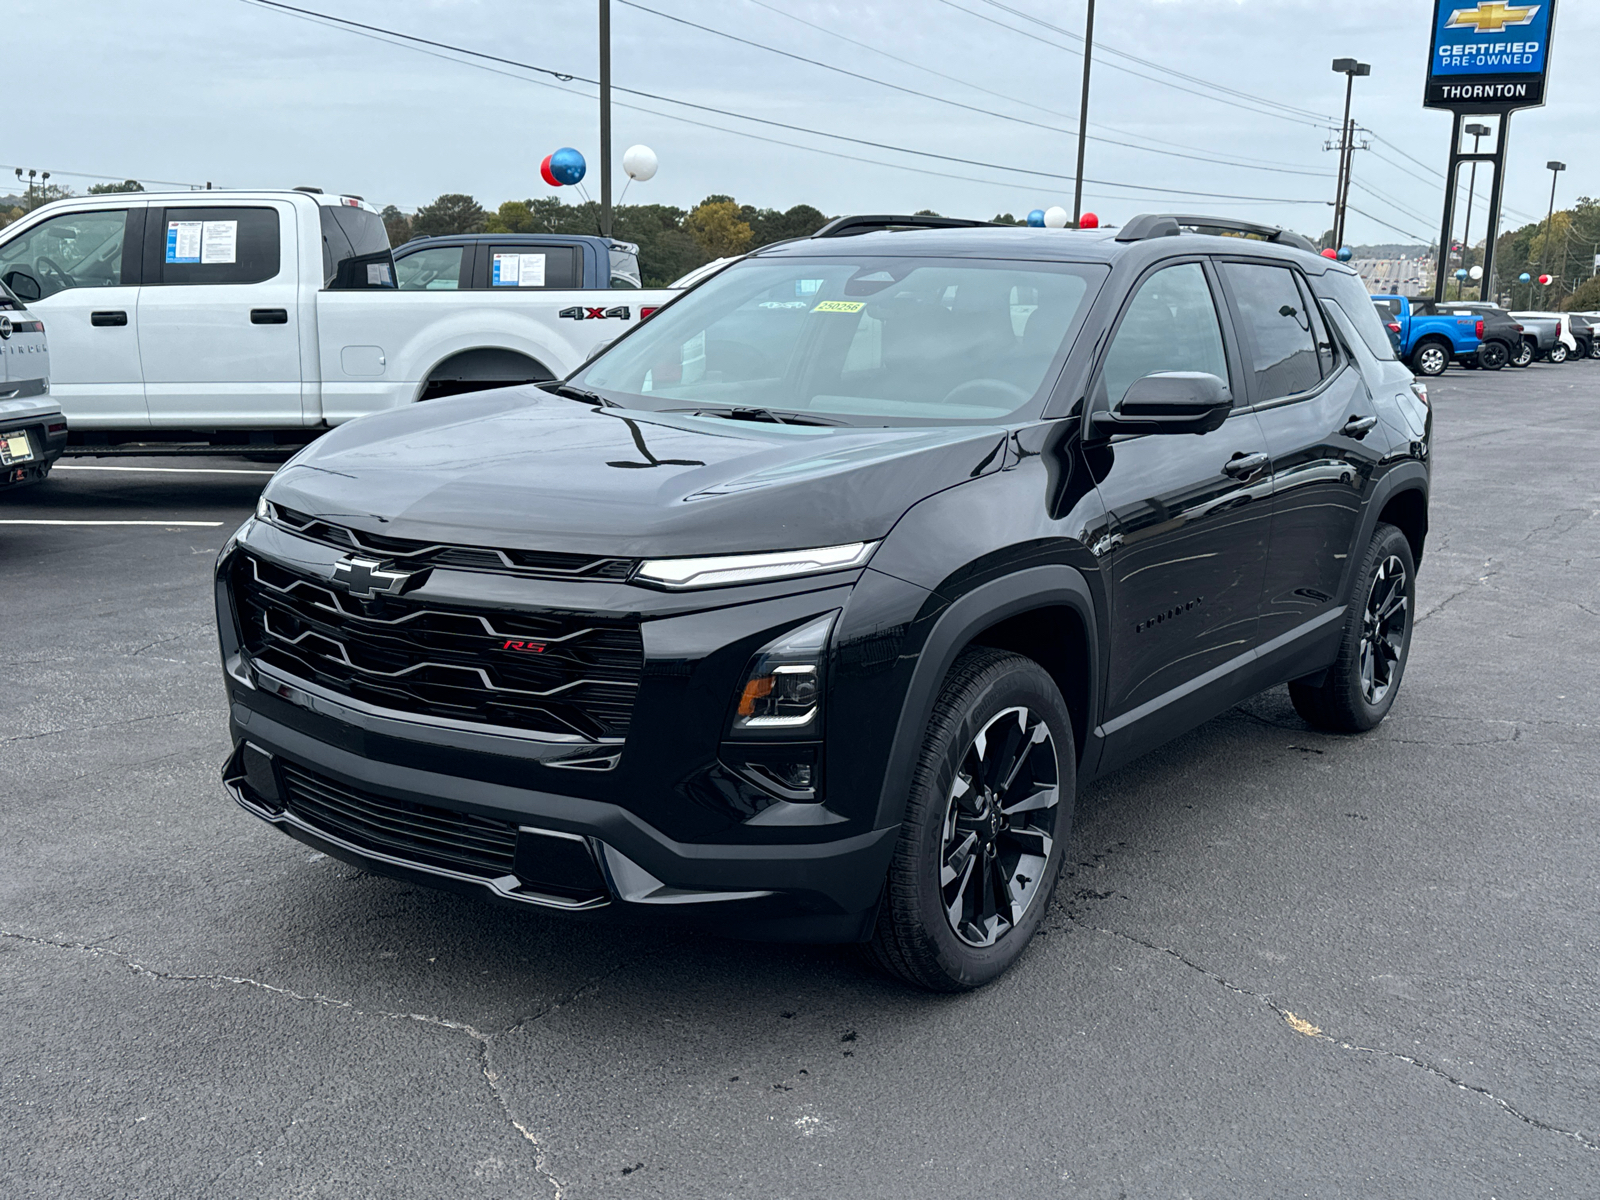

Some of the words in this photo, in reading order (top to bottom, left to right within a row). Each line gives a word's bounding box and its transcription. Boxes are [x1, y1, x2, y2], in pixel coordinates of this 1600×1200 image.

[1439, 42, 1539, 56] CERTIFIED
[1442, 54, 1533, 67] PRE-OWNED
[1442, 84, 1527, 98] THORNTON
[818, 303, 860, 311] 250256
[503, 640, 547, 652] RS
